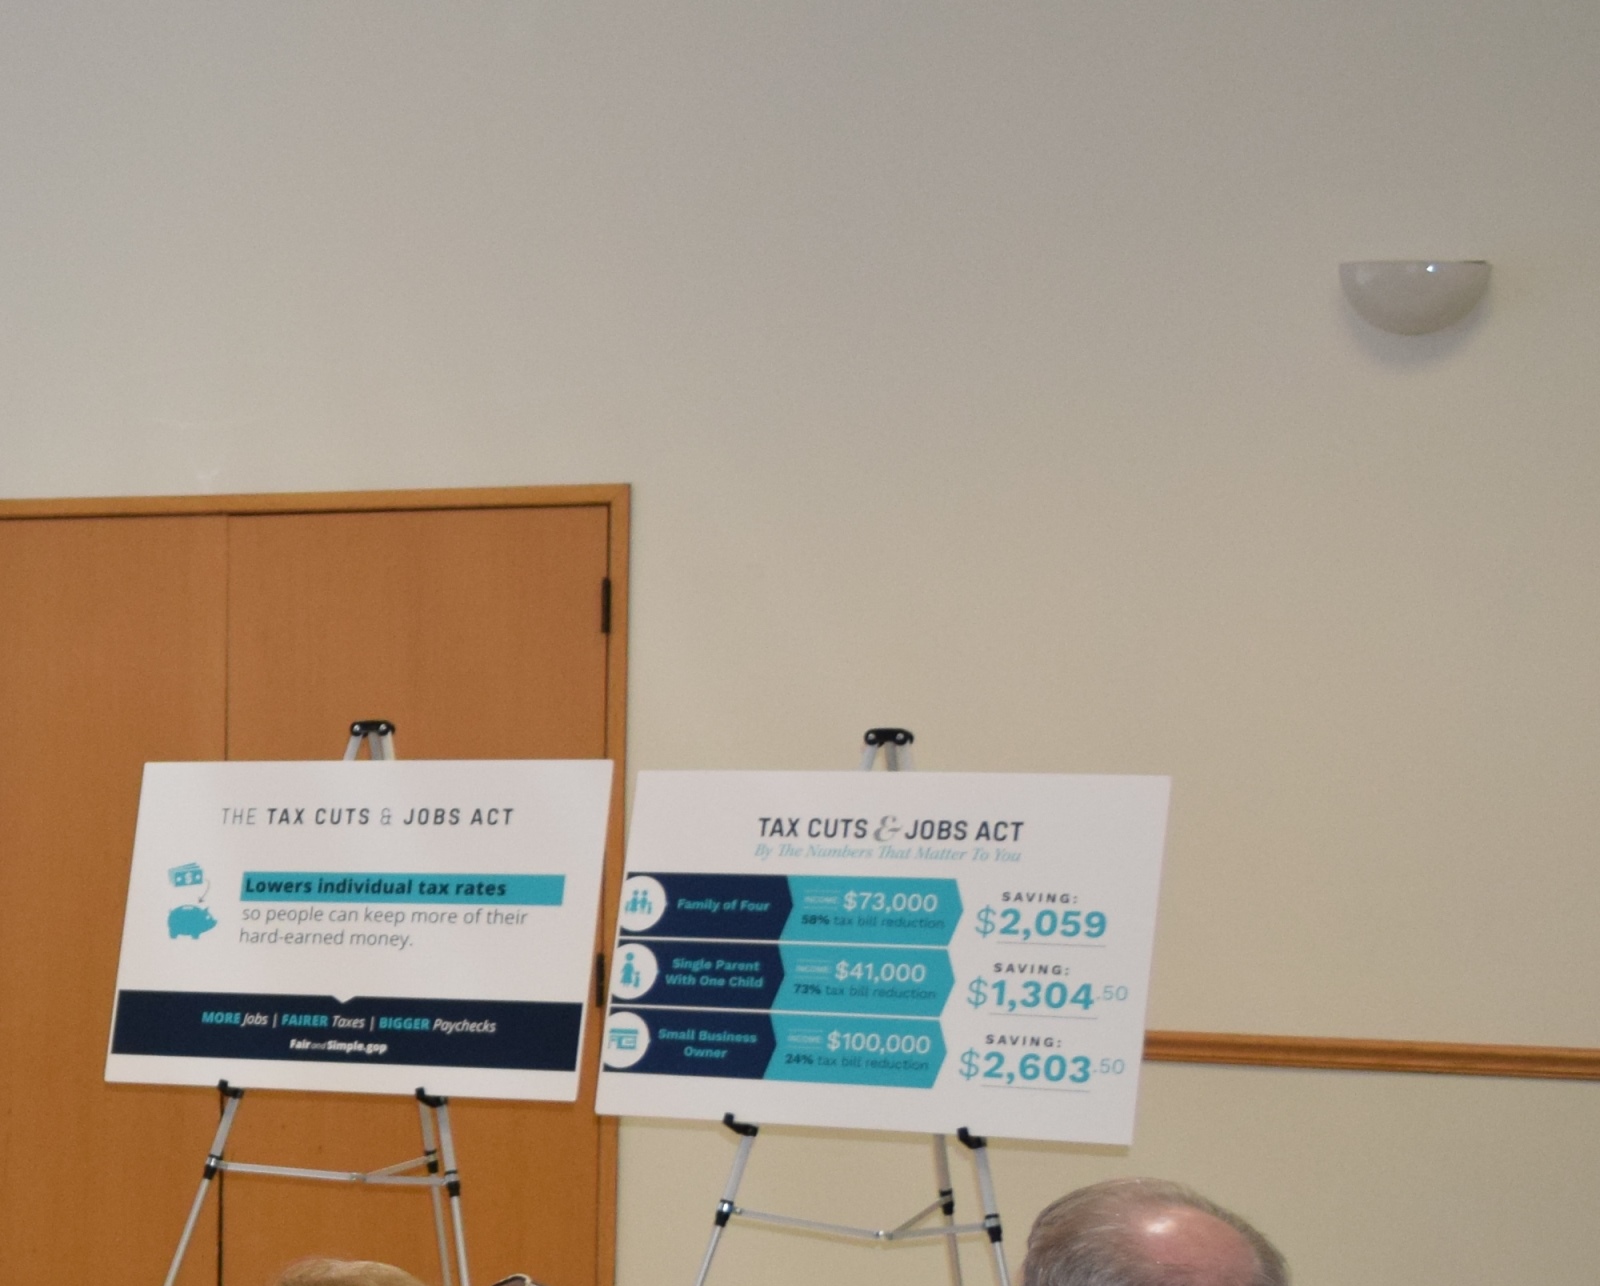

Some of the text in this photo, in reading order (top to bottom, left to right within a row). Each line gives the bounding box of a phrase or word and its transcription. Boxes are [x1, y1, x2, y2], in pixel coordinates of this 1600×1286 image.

[222, 807, 514, 825] THE TAX CUTS & JOBS ACT
[758, 814, 1024, 843] TAX CUTS & JOBS ACT
[754, 843, 1022, 863] By The Numbers That Matter To You
[245, 877, 507, 897] Lowers individual tax rates
[676, 897, 770, 913] Family of Four
[842, 889, 939, 915] $73,000
[1001, 891, 1079, 904] SAVING:
[242, 905, 528, 926] so people can keep more of their
[833, 915, 854, 926] tax
[857, 915, 877, 927] bill
[881, 917, 945, 930] reduction
[975, 904, 1107, 941] $2,059
[239, 928, 414, 950] hard-earned money.
[672, 957, 760, 973] Single Parent
[835, 959, 927, 985] $41,000
[993, 962, 1070, 976] SAVING:
[665, 974, 764, 988] With One Child
[793, 983, 936, 999] 73% tax bill reduction
[201, 1011, 497, 1035] MORE Jobs FAIRER Taxes BIGGER Paychecks
[658, 1028, 758, 1043] Small Business
[826, 1029, 931, 1055] $100,000
[984, 1033, 1062, 1048] SAVING:
[683, 1046, 728, 1059] Owner
[784, 1053, 929, 1070] 24% tax bill reduction
